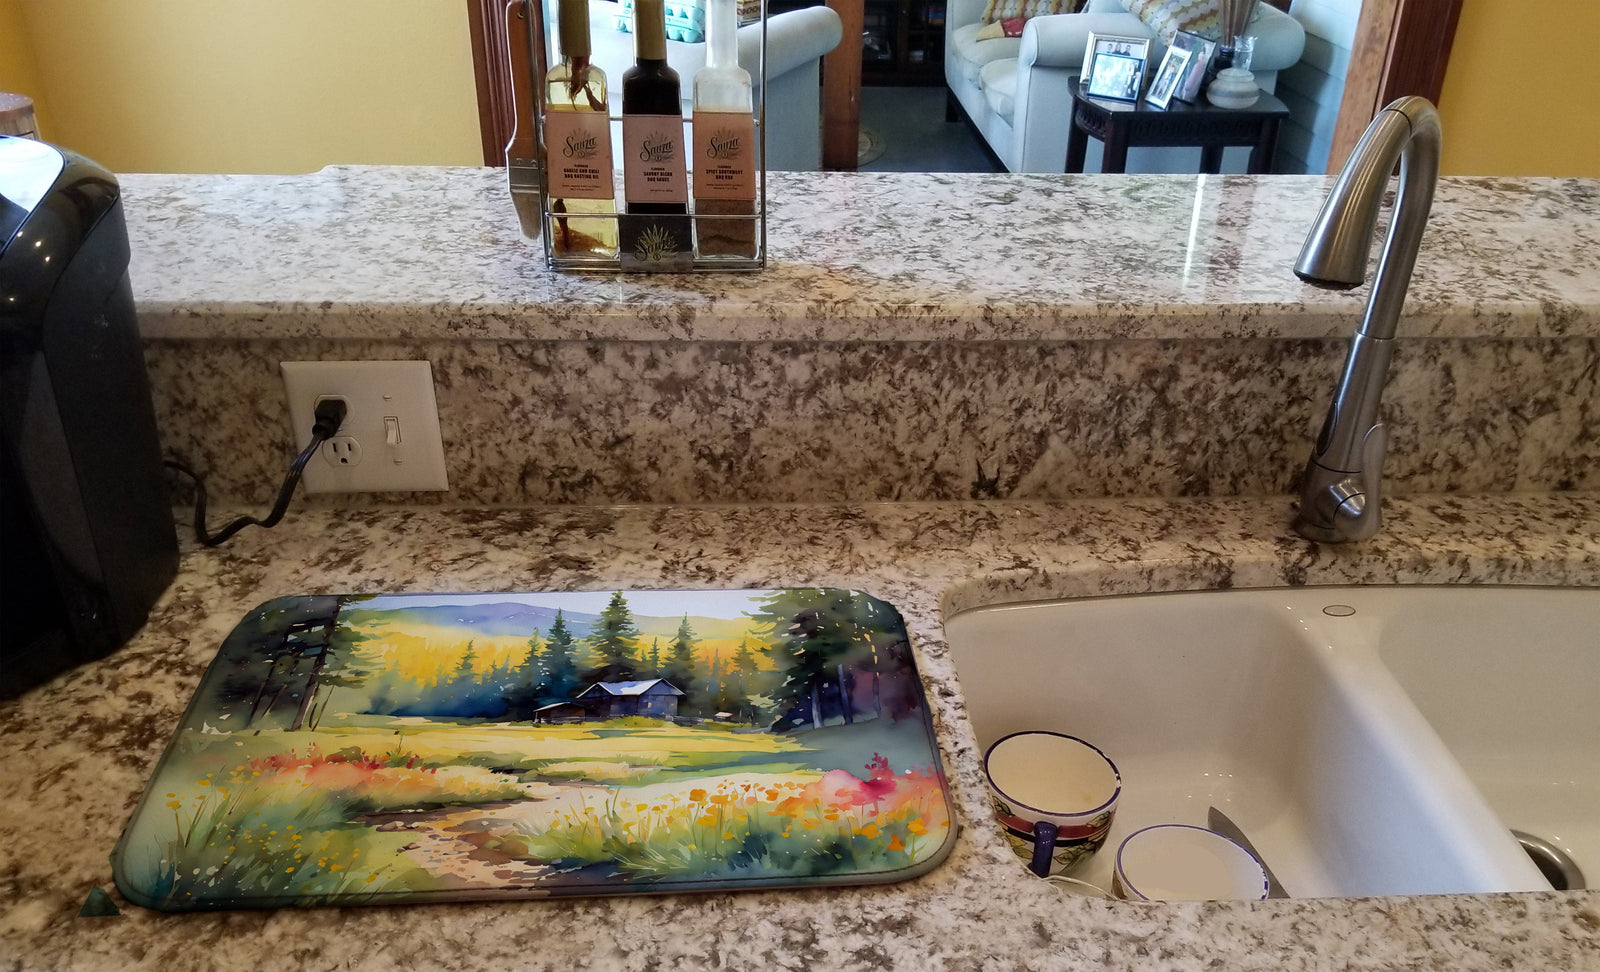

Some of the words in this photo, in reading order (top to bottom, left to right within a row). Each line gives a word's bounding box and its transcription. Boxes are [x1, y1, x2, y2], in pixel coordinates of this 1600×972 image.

[563, 136, 597, 158] Sauza
[640, 139, 673, 162] Sauza
[706, 136, 739, 159] Sauza
